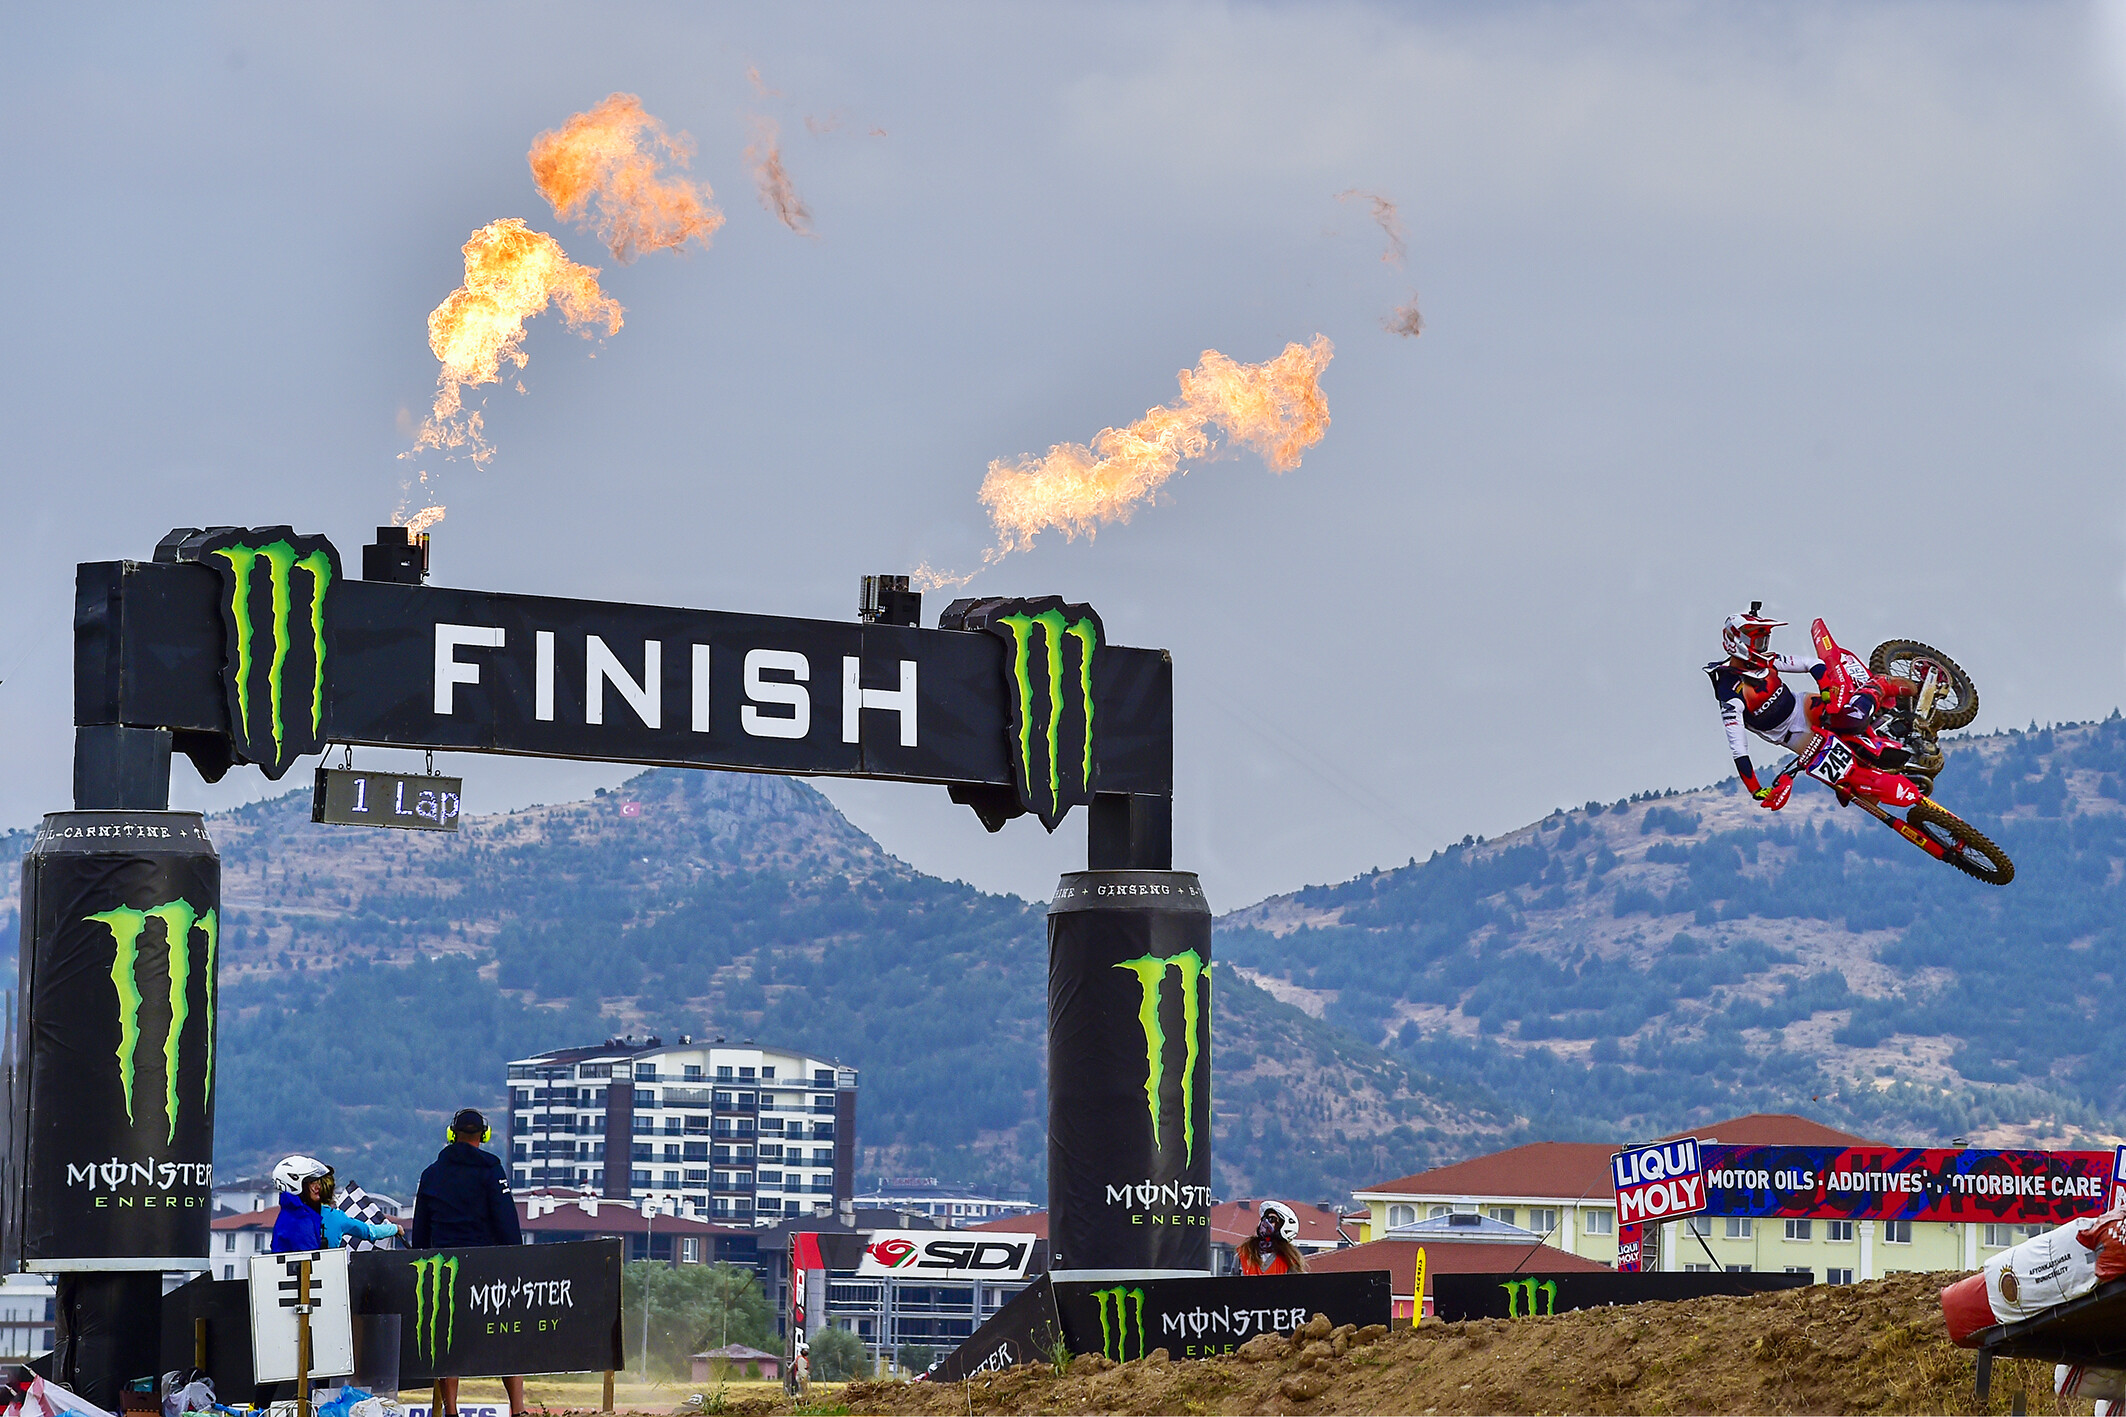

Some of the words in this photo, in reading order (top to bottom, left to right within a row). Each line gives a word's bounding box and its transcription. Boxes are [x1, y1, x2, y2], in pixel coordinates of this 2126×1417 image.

[433, 622, 918, 747] FINISH
[1753, 685, 1784, 716] HOND
[1819, 743, 1853, 783] 243
[351, 778, 369, 812] 1
[395, 781, 460, 826] Lap
[1097, 884, 1170, 897] GINSENG
[66, 1157, 213, 1192] MONSTER
[1616, 1142, 1696, 1187] LIQUI
[1619, 1176, 1700, 1221] MOLY
[1708, 1169, 1770, 1190] MOTOR
[1774, 1170, 1814, 1191] OILS
[1827, 1171, 1923, 1193] ADDITIVES
[1937, 1174, 2046, 1196] OTORBIKE
[2051, 1176, 2102, 1197] CARE
[95, 1196, 205, 1208] ENERGY
[917, 1240, 1028, 1271] SIDI
[1618, 1251, 1640, 1264] MOLY
[486, 1319, 559, 1334] ENEGY
[1161, 1305, 1307, 1339] MONSTER
